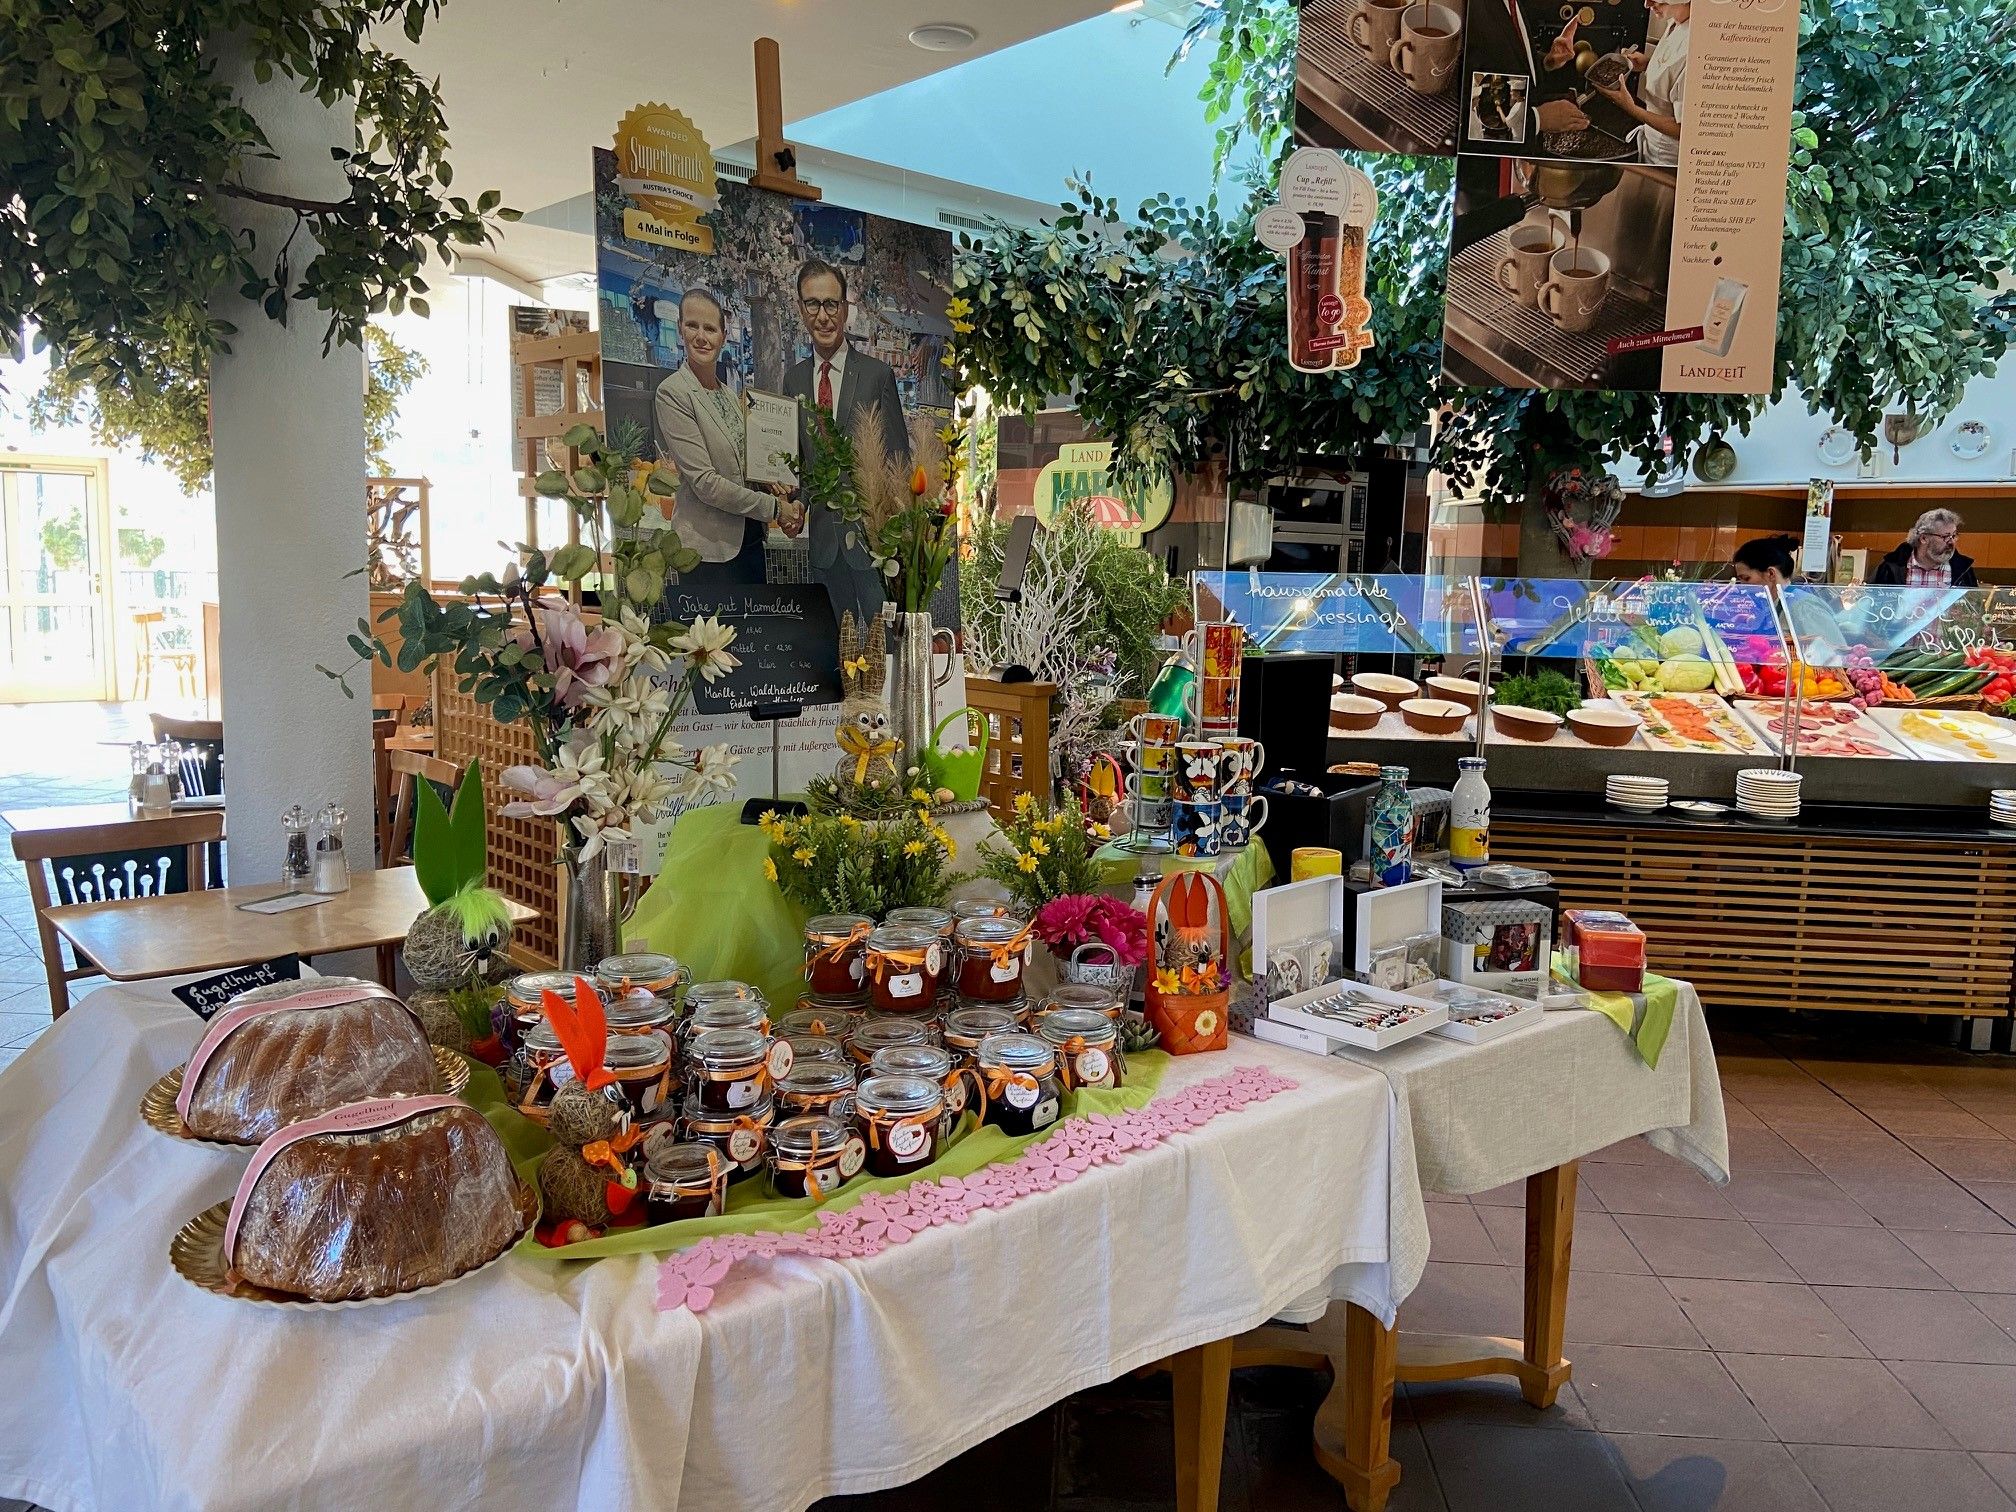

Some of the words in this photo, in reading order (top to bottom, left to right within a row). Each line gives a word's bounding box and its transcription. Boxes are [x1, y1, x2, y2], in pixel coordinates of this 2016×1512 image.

[1724, 21, 1738, 30] der
[1738, 22, 1784, 33] hauseigenen
[1704, 54, 1738, 63] Garantiert
[1747, 56, 1771, 64] kleinen
[646, 125, 688, 142] AWARDED
[630, 136, 704, 183] Superbrands
[1296, 175, 1310, 185] Cup
[672, 188, 694, 201] CHOICE
[637, 222, 644, 232] 4
[645, 222, 663, 236] Mal
[664, 227, 673, 238] in
[675, 230, 700, 245] Folge
[1321, 307, 1330, 317] to
[1331, 309, 1341, 322] go
[1617, 340, 1636, 350] Auch
[1636, 339, 1651, 348] zum
[1652, 330, 1695, 345] Mitnehmen!
[1071, 449, 1103, 463] LAND
[678, 594, 712, 613] Take
[718, 596, 738, 612] out
[744, 597, 803, 614] Marmelade
[730, 642, 756, 653] mittel
[692, 722, 714, 732] Gast
[724, 722, 739, 730] wir
[741, 720, 771, 730] kochen
[730, 744, 755, 756] Gäste
[783, 744, 797, 752] mit
[189, 963, 277, 1005] Gugelhupf
